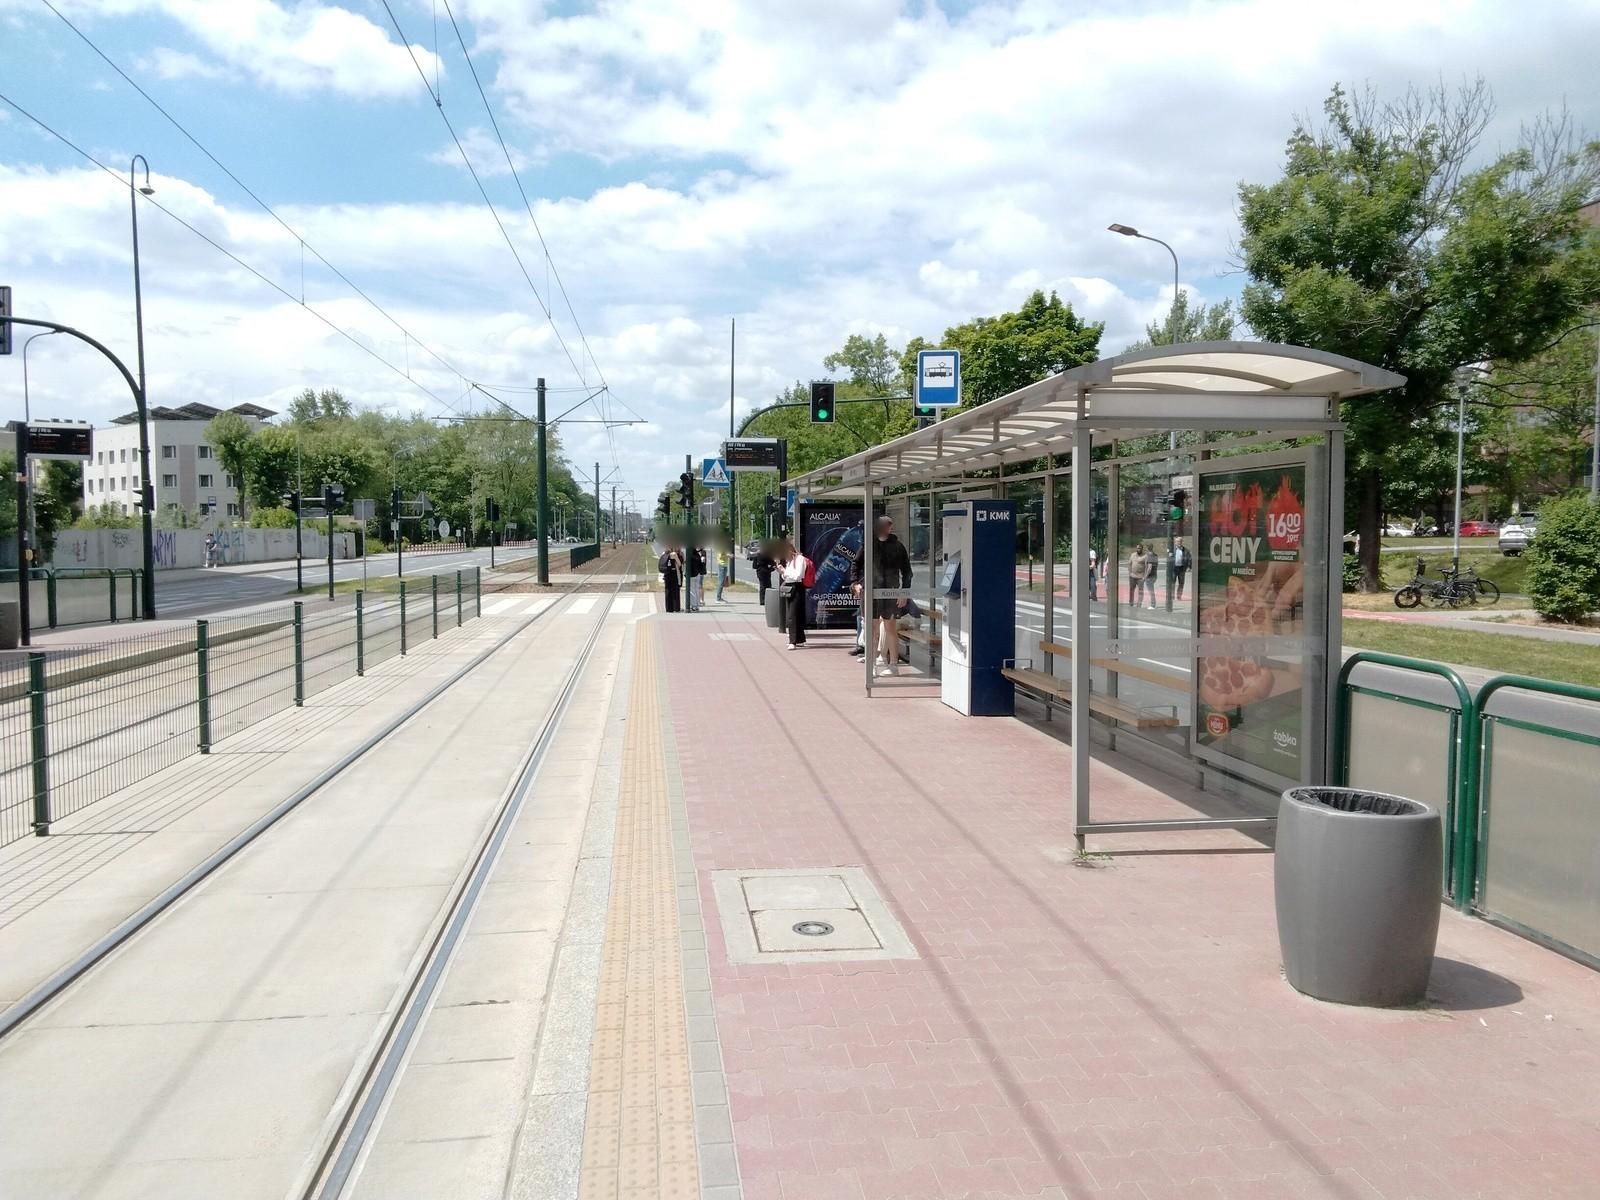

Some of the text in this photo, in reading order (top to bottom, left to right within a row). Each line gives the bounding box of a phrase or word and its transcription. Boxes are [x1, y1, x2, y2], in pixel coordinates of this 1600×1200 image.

[990, 511, 1010, 520] KMK
[1209, 486, 1263, 536] HOT
[1210, 536, 1262, 564] CENY
